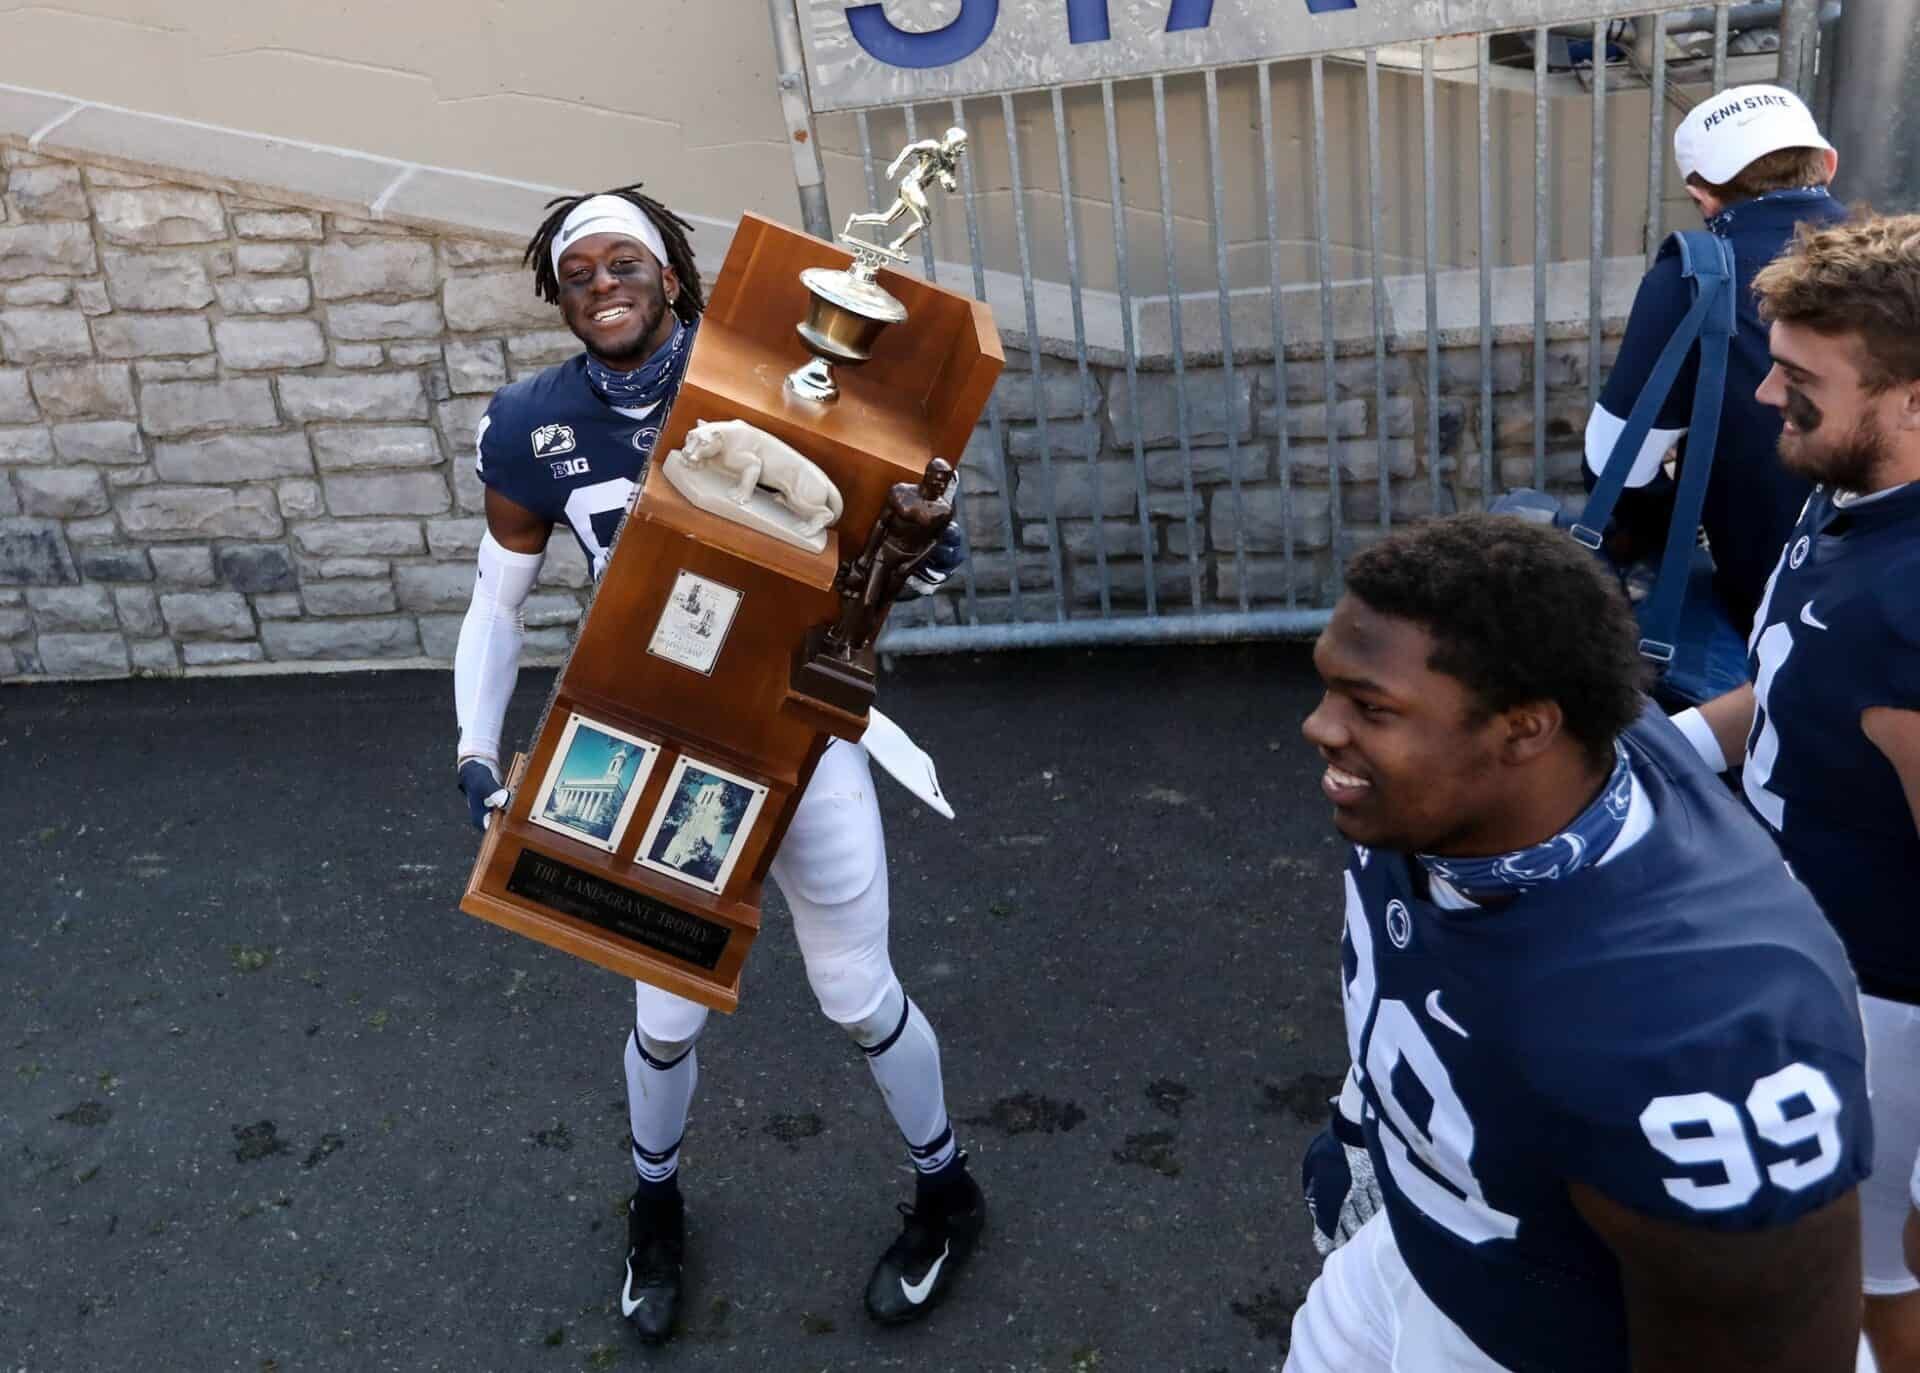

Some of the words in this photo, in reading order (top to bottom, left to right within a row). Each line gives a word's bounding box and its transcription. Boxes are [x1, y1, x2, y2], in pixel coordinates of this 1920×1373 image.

[1703, 101, 1742, 131] PENN
[1744, 94, 1791, 109] STATE
[533, 861, 560, 882] THE
[1638, 1061, 1842, 1211] 99
